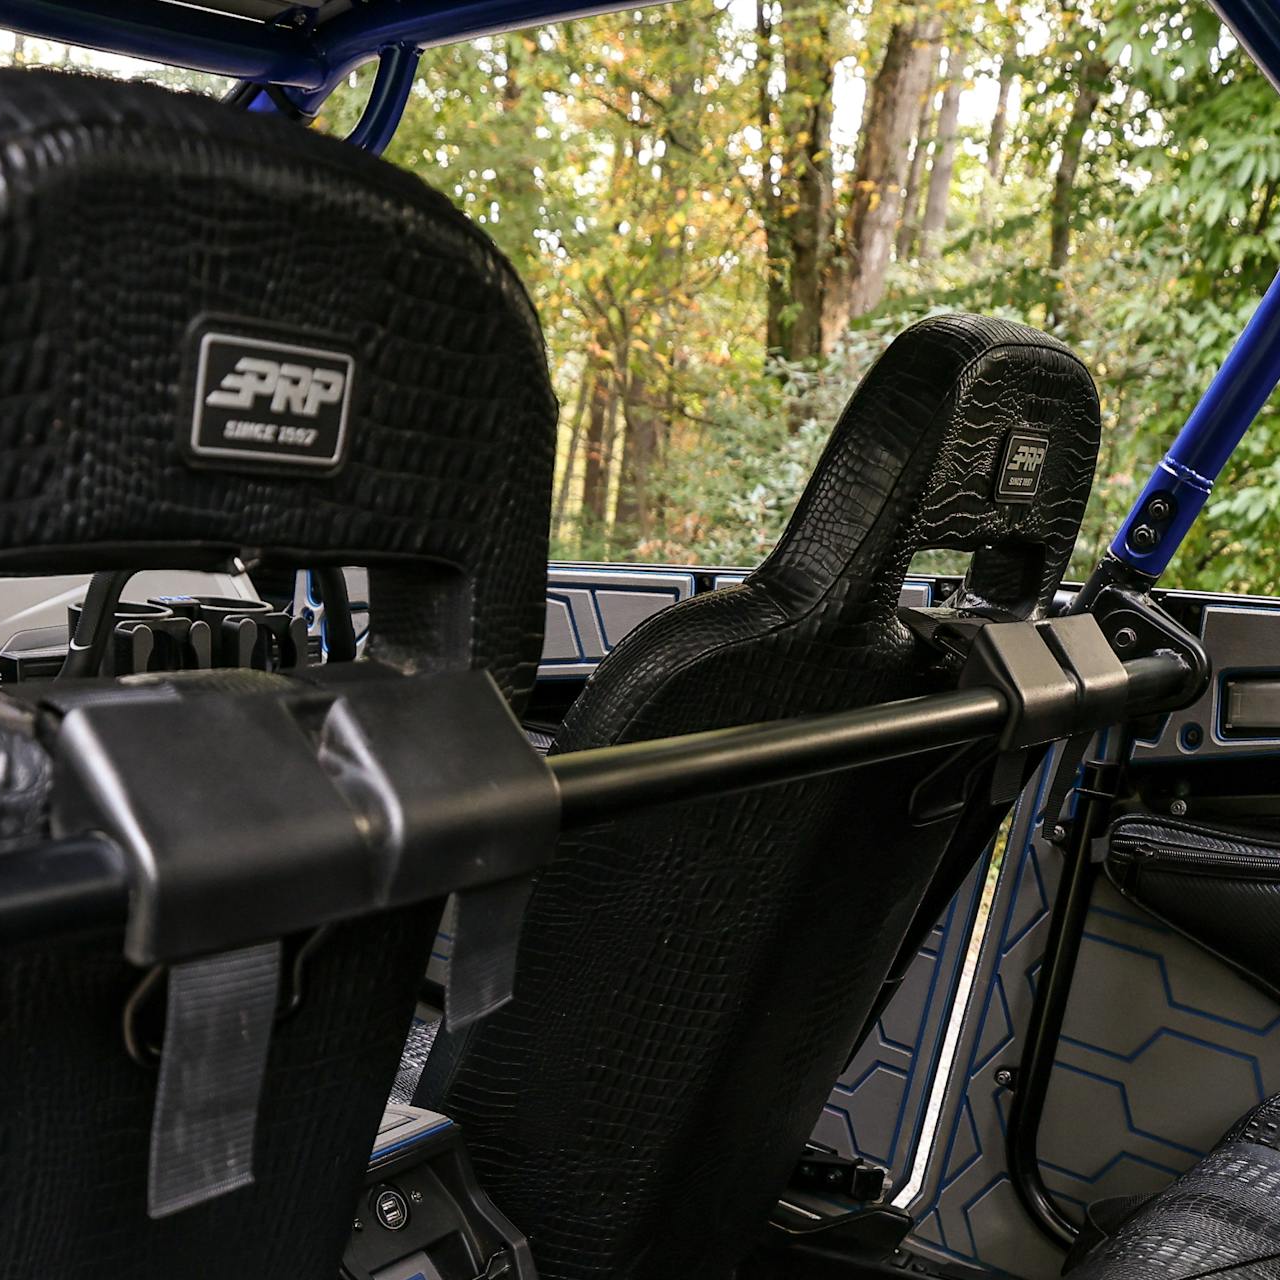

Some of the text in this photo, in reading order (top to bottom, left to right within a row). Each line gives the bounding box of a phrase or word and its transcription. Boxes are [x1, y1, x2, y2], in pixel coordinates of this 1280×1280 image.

[206, 356, 345, 418] PRP
[223, 420, 278, 443] SINCE
[1007, 446, 1046, 471] PRP
